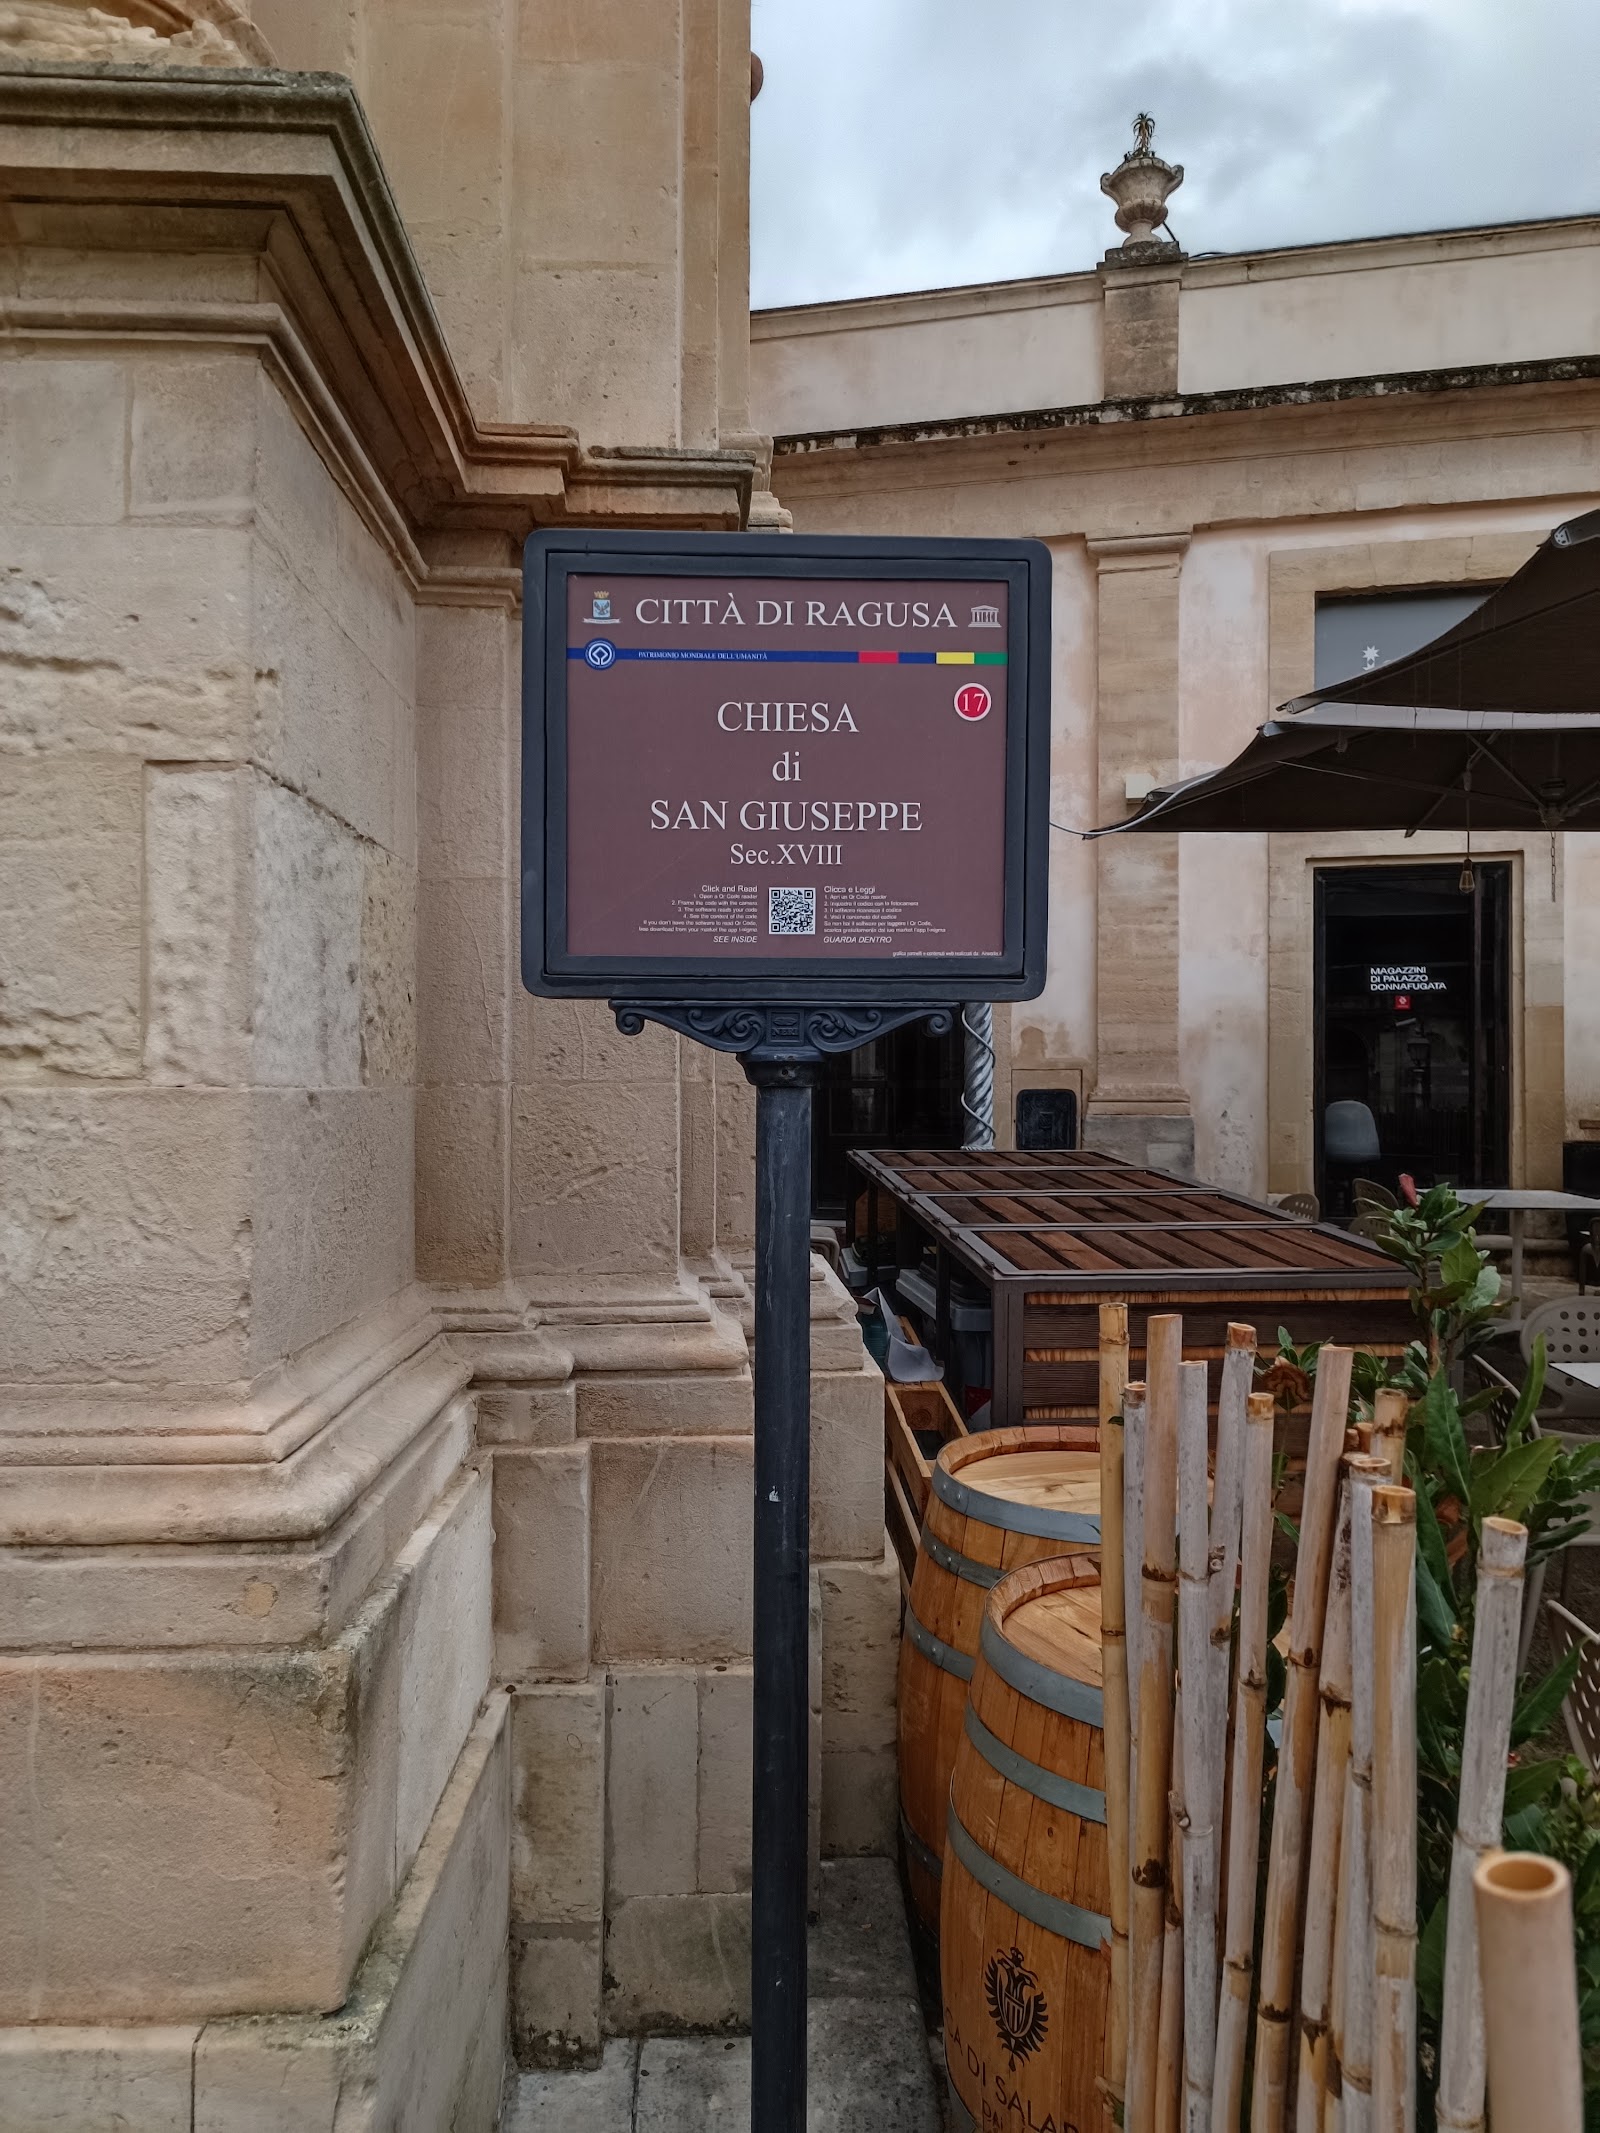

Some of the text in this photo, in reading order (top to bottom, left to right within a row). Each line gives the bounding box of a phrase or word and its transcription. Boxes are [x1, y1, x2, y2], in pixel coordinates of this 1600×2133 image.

[635, 592, 958, 628] CITTÀ DI RAGUSA
[638, 651, 768, 660] PATRIMONIO MONDIALE DELL'UMANITÀ
[962, 693, 985, 712] 17
[717, 701, 860, 733] CHIESA
[772, 751, 802, 782] di
[650, 800, 923, 831] SAN GIUSEPPE
[730, 843, 843, 865] Sec.XVIII
[823, 885, 876, 894] Clicca e Leggi
[713, 935, 758, 943] SEE INSIDE
[1370, 966, 1427, 975] MAGAZZINI
[1370, 974, 1429, 983] DI PALAZZO
[1370, 982, 1447, 991] DONNAFUGATA
